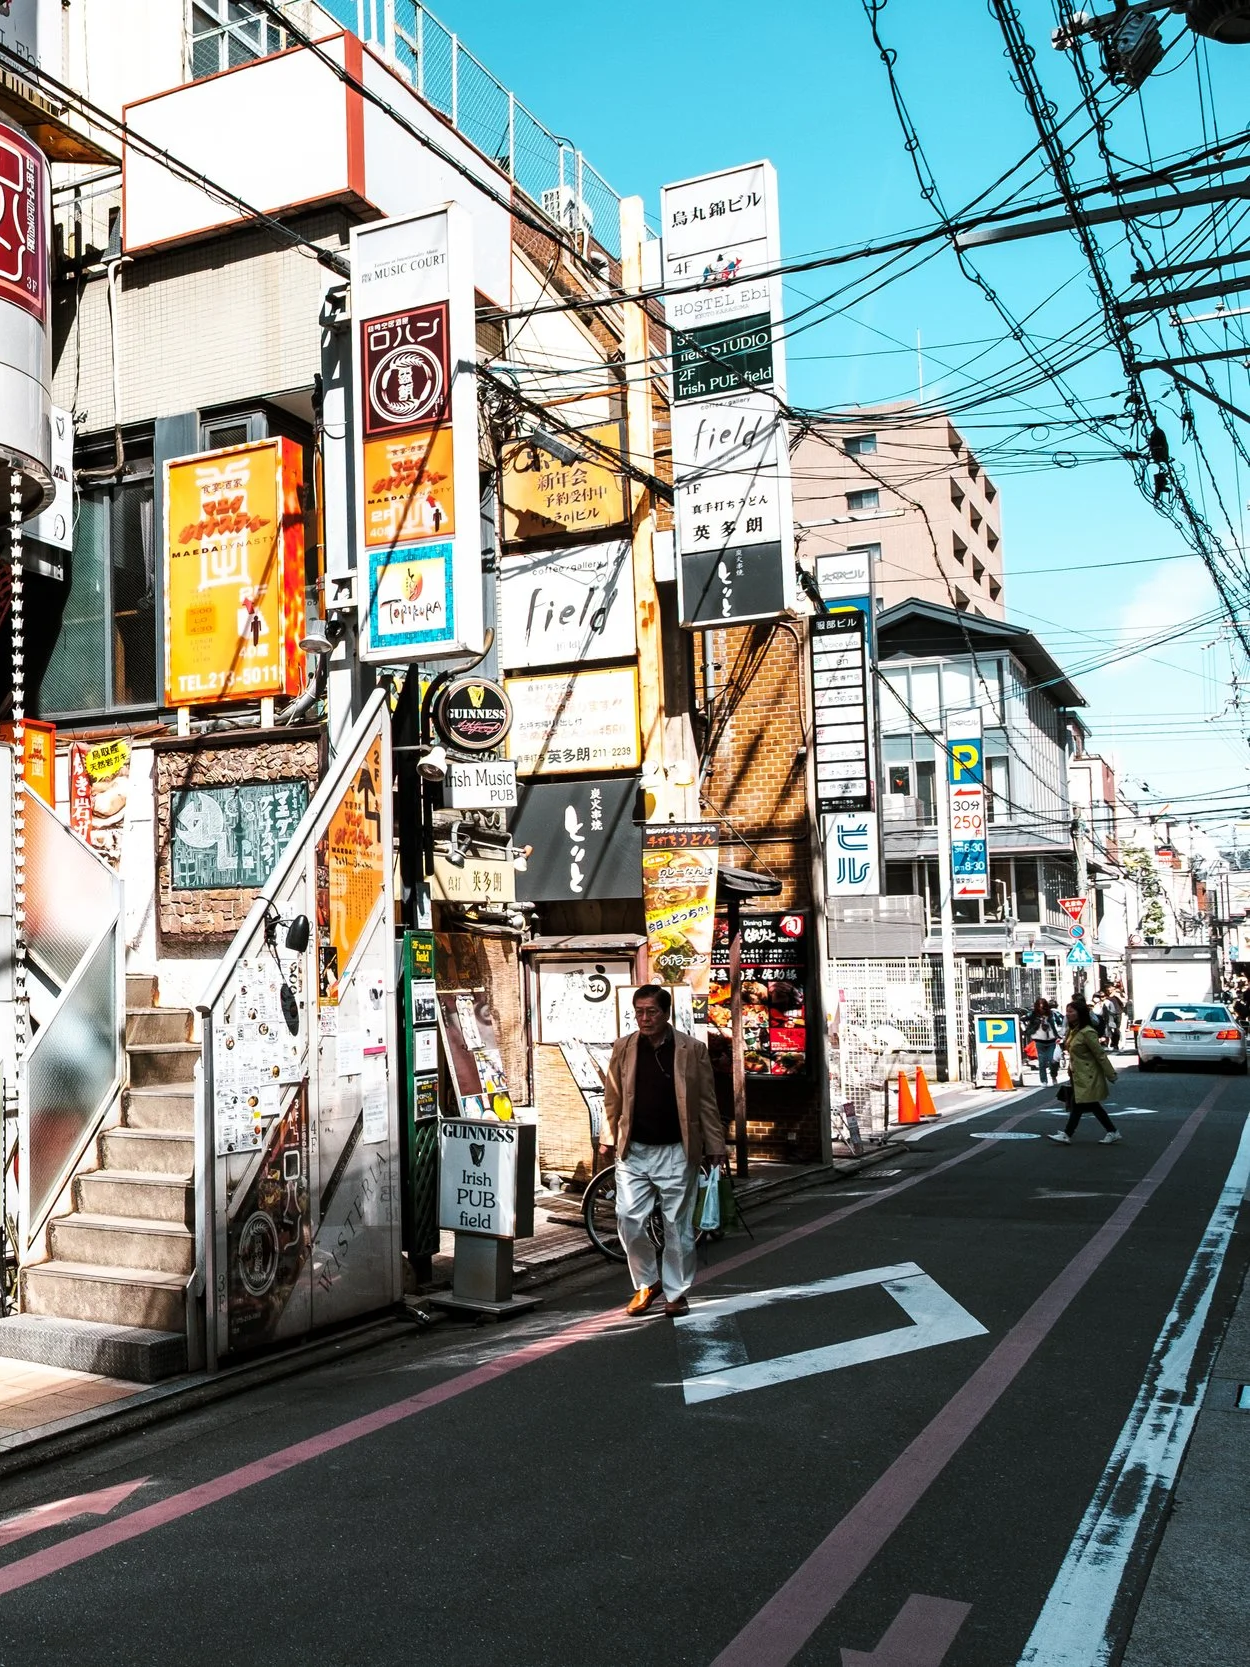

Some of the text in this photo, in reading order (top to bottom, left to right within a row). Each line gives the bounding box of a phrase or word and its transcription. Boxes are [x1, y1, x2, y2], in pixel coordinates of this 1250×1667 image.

[374, 263, 407, 280] MUSIC
[410, 253, 446, 271] COURT
[673, 260, 693, 276] 4F
[27, 276, 37, 292] 3F
[674, 285, 770, 317] HOSTEL Ebi
[370, 318, 439, 351] ロハン
[711, 332, 769, 356] STUDIO
[678, 368, 695, 382] 2F
[678, 381, 706, 396] Irish
[742, 367, 772, 385] field
[694, 416, 762, 462] field
[537, 468, 588, 491] 新年会
[685, 483, 702, 495] 1F
[693, 516, 763, 542] 英多朗
[525, 588, 619, 647] field
[448, 708, 507, 720] GUINNESS
[547, 747, 591, 764] 英多朗
[953, 745, 979, 780] P
[445, 768, 513, 787] Irish Music
[490, 789, 514, 801] PUB
[590, 788, 603, 831] 炭火串焼
[953, 801, 980, 811] 30分
[954, 815, 982, 829] 250
[647, 834, 716, 848] 手打ちうどん
[743, 919, 762, 928] Dining
[986, 1020, 1008, 1041] P
[311, 1120, 317, 1154] 4F
[443, 1124, 514, 1143] GUINNESS
[462, 1169, 492, 1187] Irish
[457, 1188, 496, 1208] PUB
[318, 1151, 388, 1294] WISTERIA
[460, 1210, 491, 1229] field
